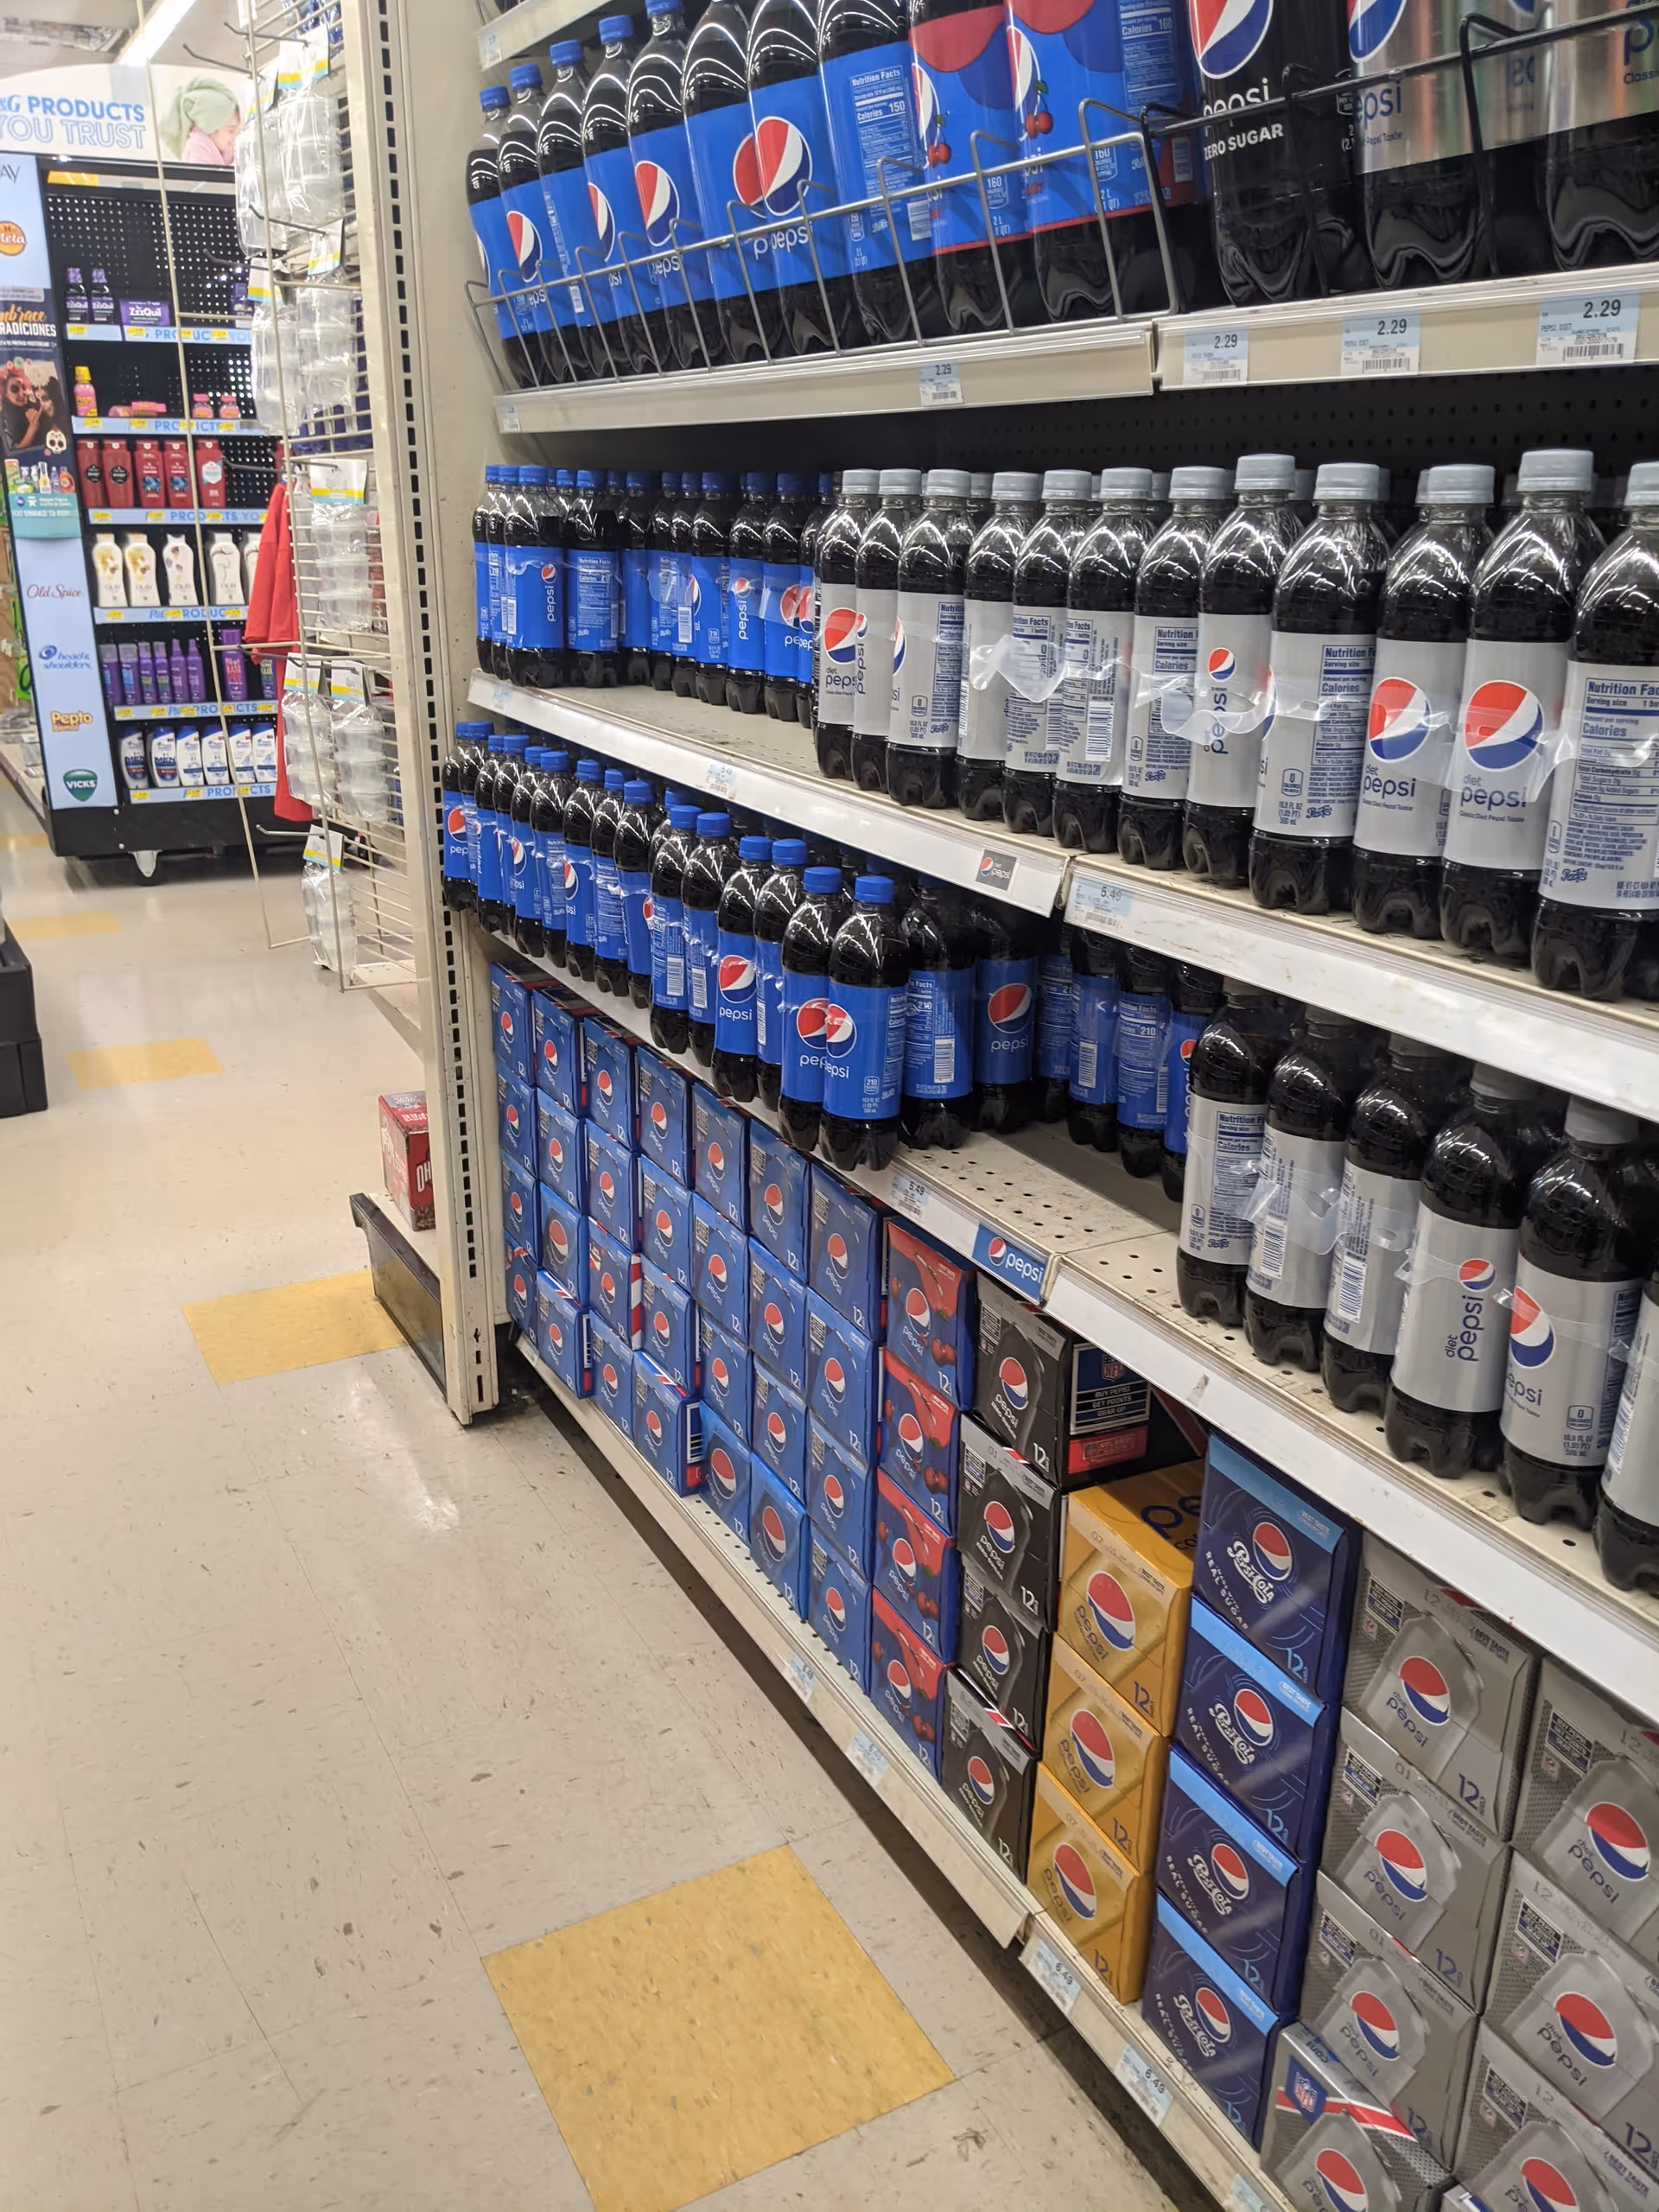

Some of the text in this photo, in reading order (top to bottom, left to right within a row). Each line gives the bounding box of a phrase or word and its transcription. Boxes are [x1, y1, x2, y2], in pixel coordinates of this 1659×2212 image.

[1159, 17, 1173, 30] 160
[851, 68, 902, 86] Nutrition Facts
[27, 95, 145, 122] PRODUCTS
[857, 109, 883, 123] Calories
[888, 101, 906, 114] 150
[60, 118, 146, 149] TRUST
[1205, 122, 1285, 162] ZERO SUGAR
[1094, 148, 1111, 161] 160
[987, 175, 1003, 188] 160
[1583, 300, 1622, 319] 2.29
[1377, 319, 1408, 335] 2.29
[1214, 334, 1238, 350] 2.29
[935, 365, 951, 376] 2.29
[27, 583, 82, 600] Old Spice
[547, 585, 556, 622] pepsi
[738, 599, 747, 641] pepsi
[1156, 628, 1194, 639] Nutrition
[1325, 647, 1366, 658] Nutrition
[856, 642, 866, 695] pepsi
[1155, 659, 1188, 671] Calories
[1322, 682, 1360, 693] Calories
[1587, 681, 1637, 696] Nutrition
[1586, 696, 1627, 707] Serving size
[51, 709, 93, 724] Pepto
[1582, 722, 1628, 737] Calories
[1365, 764, 1379, 776] diet
[66, 778, 97, 790] VICKS
[1363, 776, 1415, 798] pepsi
[1460, 785, 1528, 808] pepsi
[1488, 812, 1505, 822] Pepsi
[991, 865, 1010, 880] pepsi
[1100, 886, 1122, 901] 5.49
[916, 981, 933, 989] Facts
[719, 1004, 753, 1022] pepsi
[917, 1001, 933, 1010] 210
[1141, 1026, 1157, 1036] 210
[991, 1035, 1029, 1054] pepsi
[1219, 1113, 1255, 1124] Nutrition
[651, 1131, 664, 1153] pepsi
[1217, 1141, 1251, 1152] Calories
[707, 1172, 721, 1194] pepsi
[908, 1180, 925, 1197] 5.49
[762, 1215, 778, 1241] pepsi
[654, 1236, 668, 1260] pepsi
[1005, 1252, 1044, 1284] pepsi
[826, 1267, 842, 1295] pepsi
[707, 1281, 722, 1306] pepsi
[1457, 1294, 1484, 1363] pepsi
[762, 1332, 779, 1358] pepsi
[903, 1325, 924, 1357] pepsi
[1444, 1333, 1459, 1358] diet
[822, 1389, 838, 1417] pepsi
[1092, 1395, 1132, 1408] GET POINTS
[1094, 1386, 1131, 1398] BUY PEPSI
[995, 1393, 1020, 1428] pepsi
[1097, 1408, 1116, 1417] GEAR
[1578, 1409, 1585, 1420] 0
[895, 1448, 917, 1480] pepsi
[822, 1502, 837, 1532] pepsi
[980, 1535, 1006, 1571] pepsi
[889, 1569, 909, 1603] pepsi
[1205, 1551, 1221, 1586] REAL
[1219, 1589, 1249, 1630] SUGAR
[1077, 1605, 1109, 1662] pepsi
[976, 1655, 1000, 1690] pepsi
[884, 1689, 905, 1722] pepsi
[1386, 1696, 1428, 1747] pepsi
[1186, 1707, 1230, 1786] REAL SUGAR
[1059, 1738, 1091, 1794] pepsi
[962, 1782, 984, 1819] pepsi
[1459, 1772, 1481, 1811] 12
[1567, 1843, 1620, 1904] pepsi
[1043, 1867, 1073, 1923] pepsi
[1363, 1870, 1408, 1921] pepsi
[1055, 1961, 1074, 1986] 6.49
[1339, 2025, 1380, 2077] pepsi
[1536, 2026, 1589, 2088] pepsi
[1143, 2067, 1166, 2095] 6.49
[1624, 2121, 1653, 2164] 12
